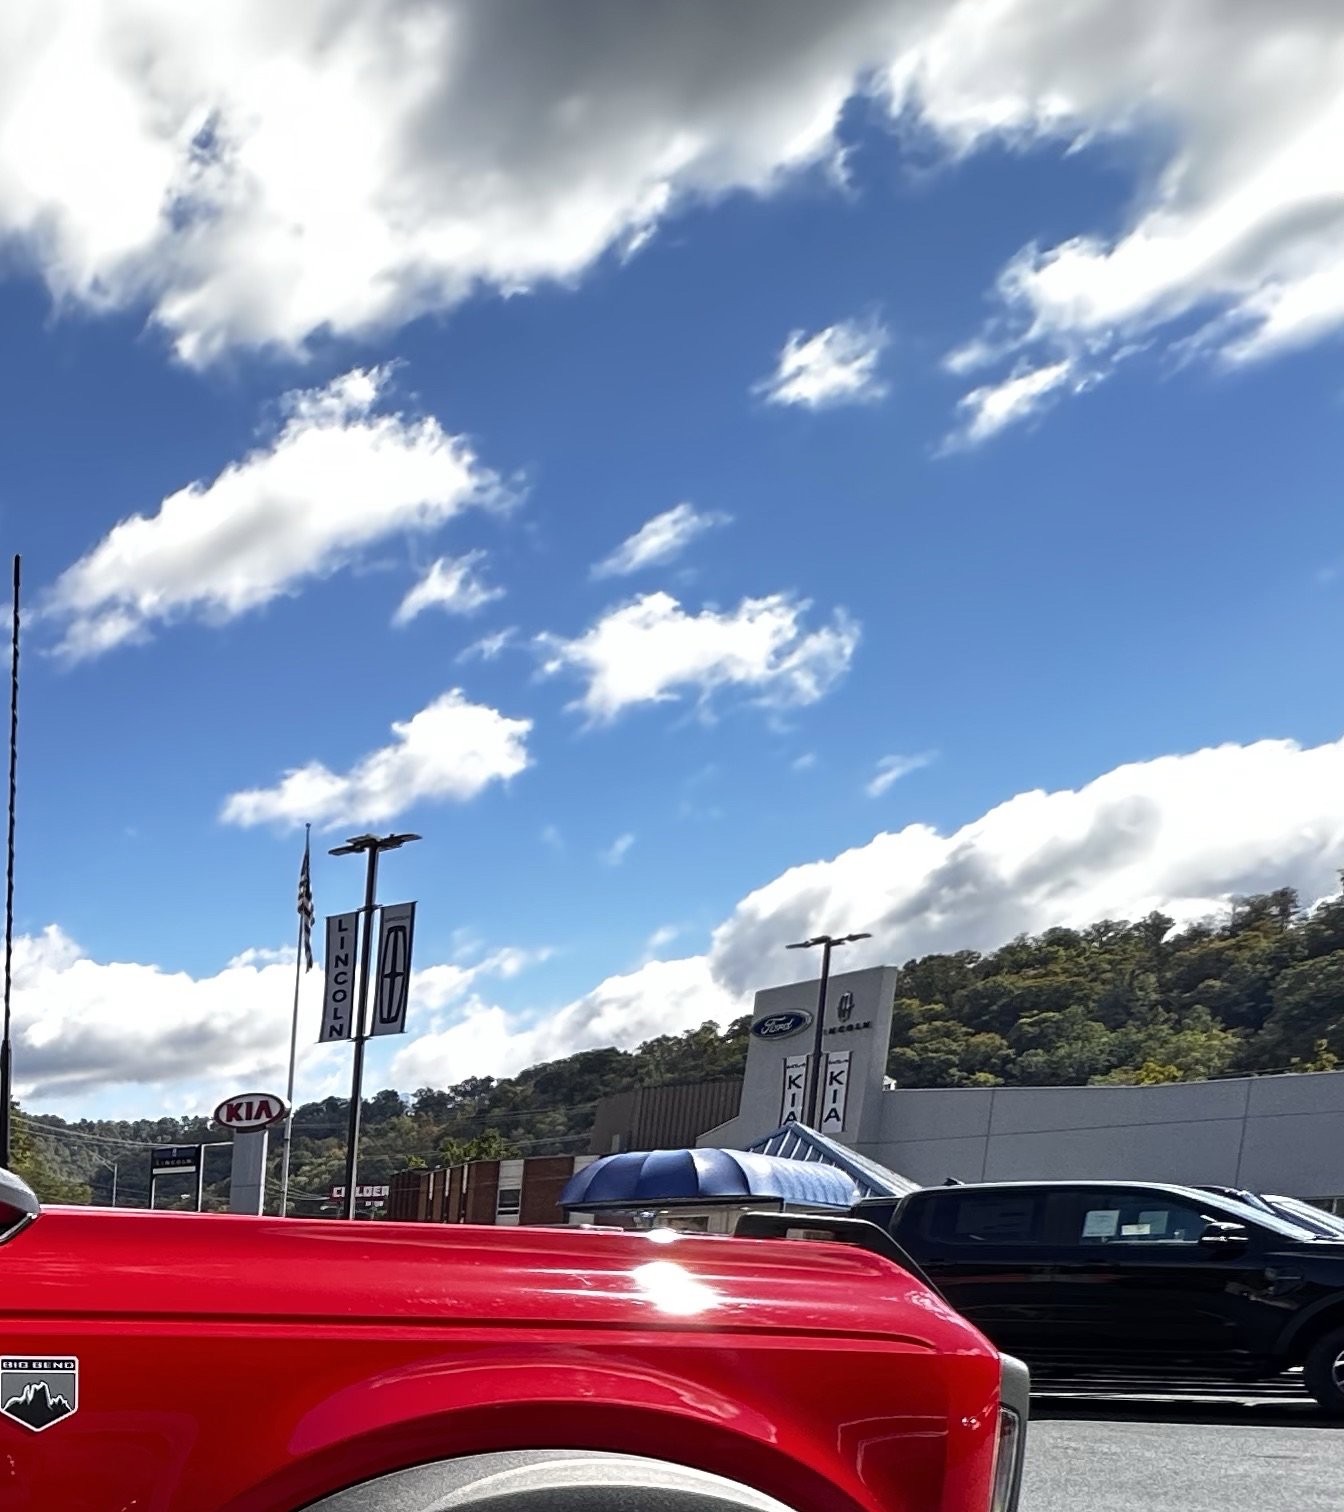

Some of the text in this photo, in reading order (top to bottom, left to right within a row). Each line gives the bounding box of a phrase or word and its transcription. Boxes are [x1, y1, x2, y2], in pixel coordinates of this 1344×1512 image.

[329, 919, 349, 1037] LINCOLN
[761, 1016, 794, 1035] Ford
[823, 1021, 871, 1036] INCOLN
[783, 1074, 803, 1126] KIA
[824, 1070, 845, 1123] KIA
[225, 1101, 274, 1122] KIA
[2, 1361, 75, 1369] BIG BEND
